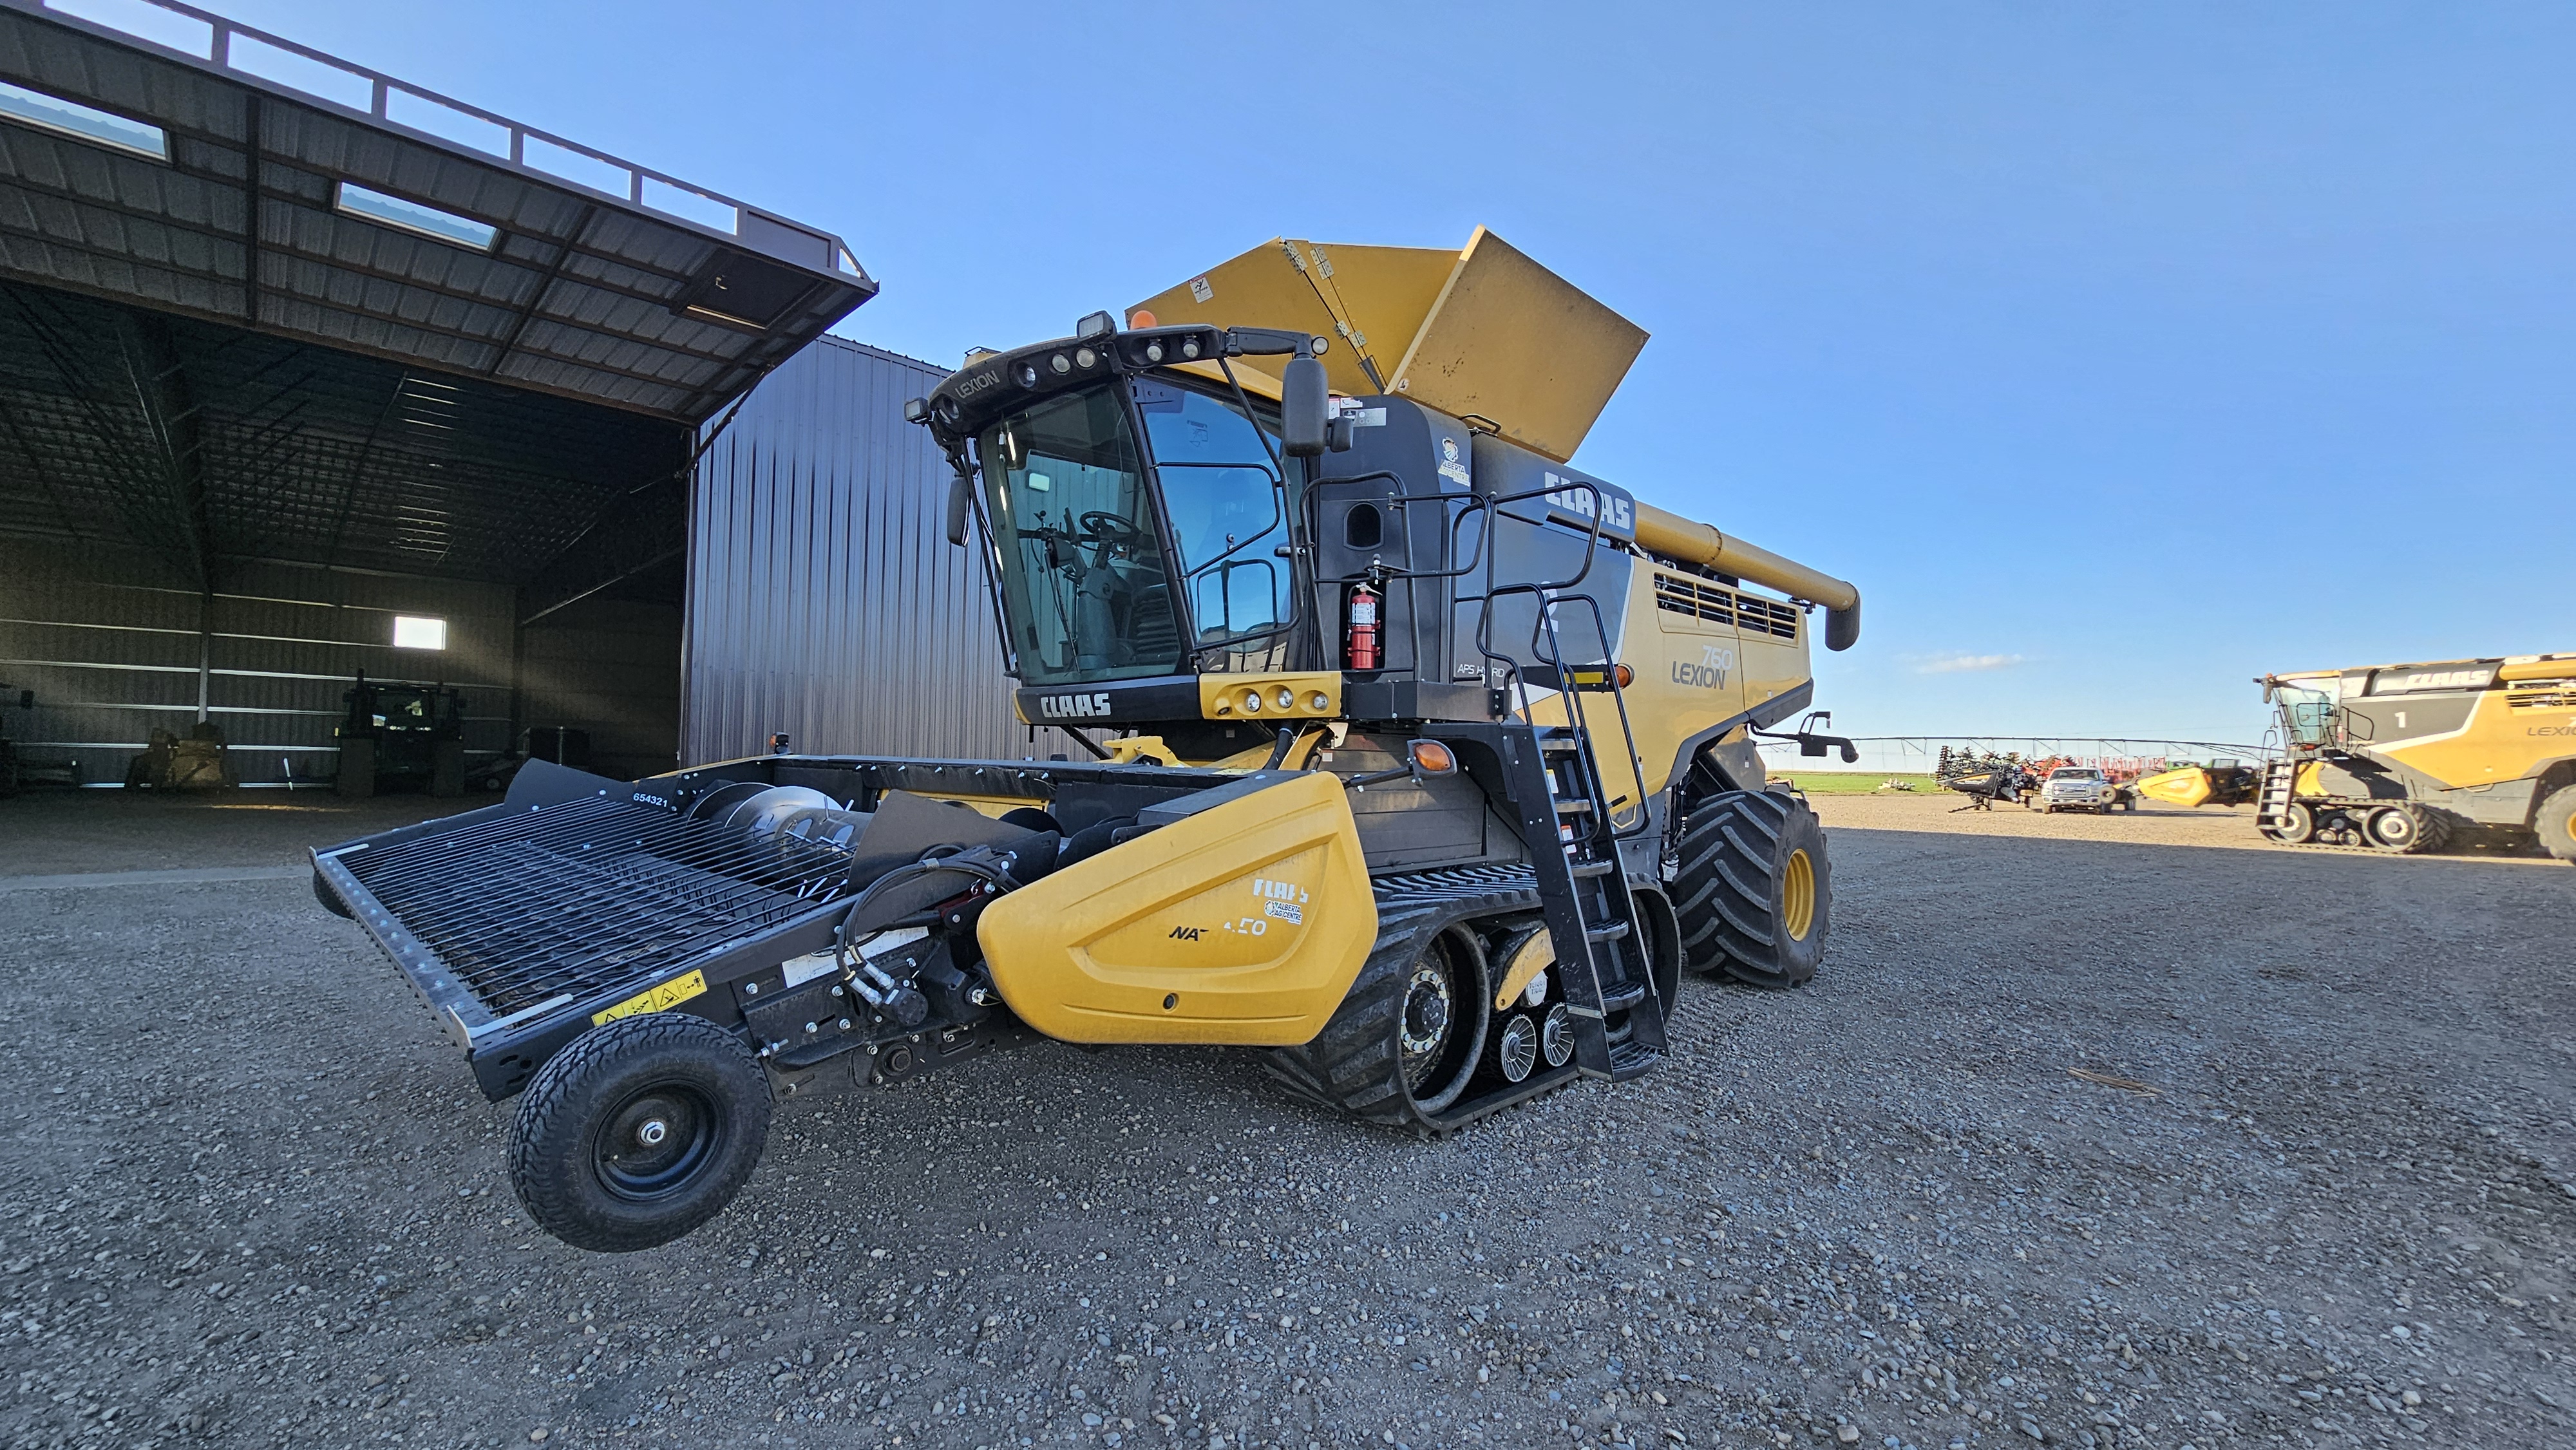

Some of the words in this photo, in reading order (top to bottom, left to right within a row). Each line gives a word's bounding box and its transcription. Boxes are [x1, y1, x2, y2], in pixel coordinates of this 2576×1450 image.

[954, 370, 1000, 399] LEXION
[1545, 471, 1630, 530] CLAAS
[1701, 645, 1733, 671] 760
[1457, 664, 1475, 675] APS
[1476, 666, 1505, 677] HRID
[1672, 661, 1725, 690] LEXION
[2405, 670, 2489, 688] CLAAS
[1041, 693, 1112, 718] CLAAS
[2394, 711, 2407, 728] 1
[633, 793, 668, 807] 654321
[1278, 903, 1300, 913] ALBERTA
[1283, 911, 1302, 921] CENTRE
